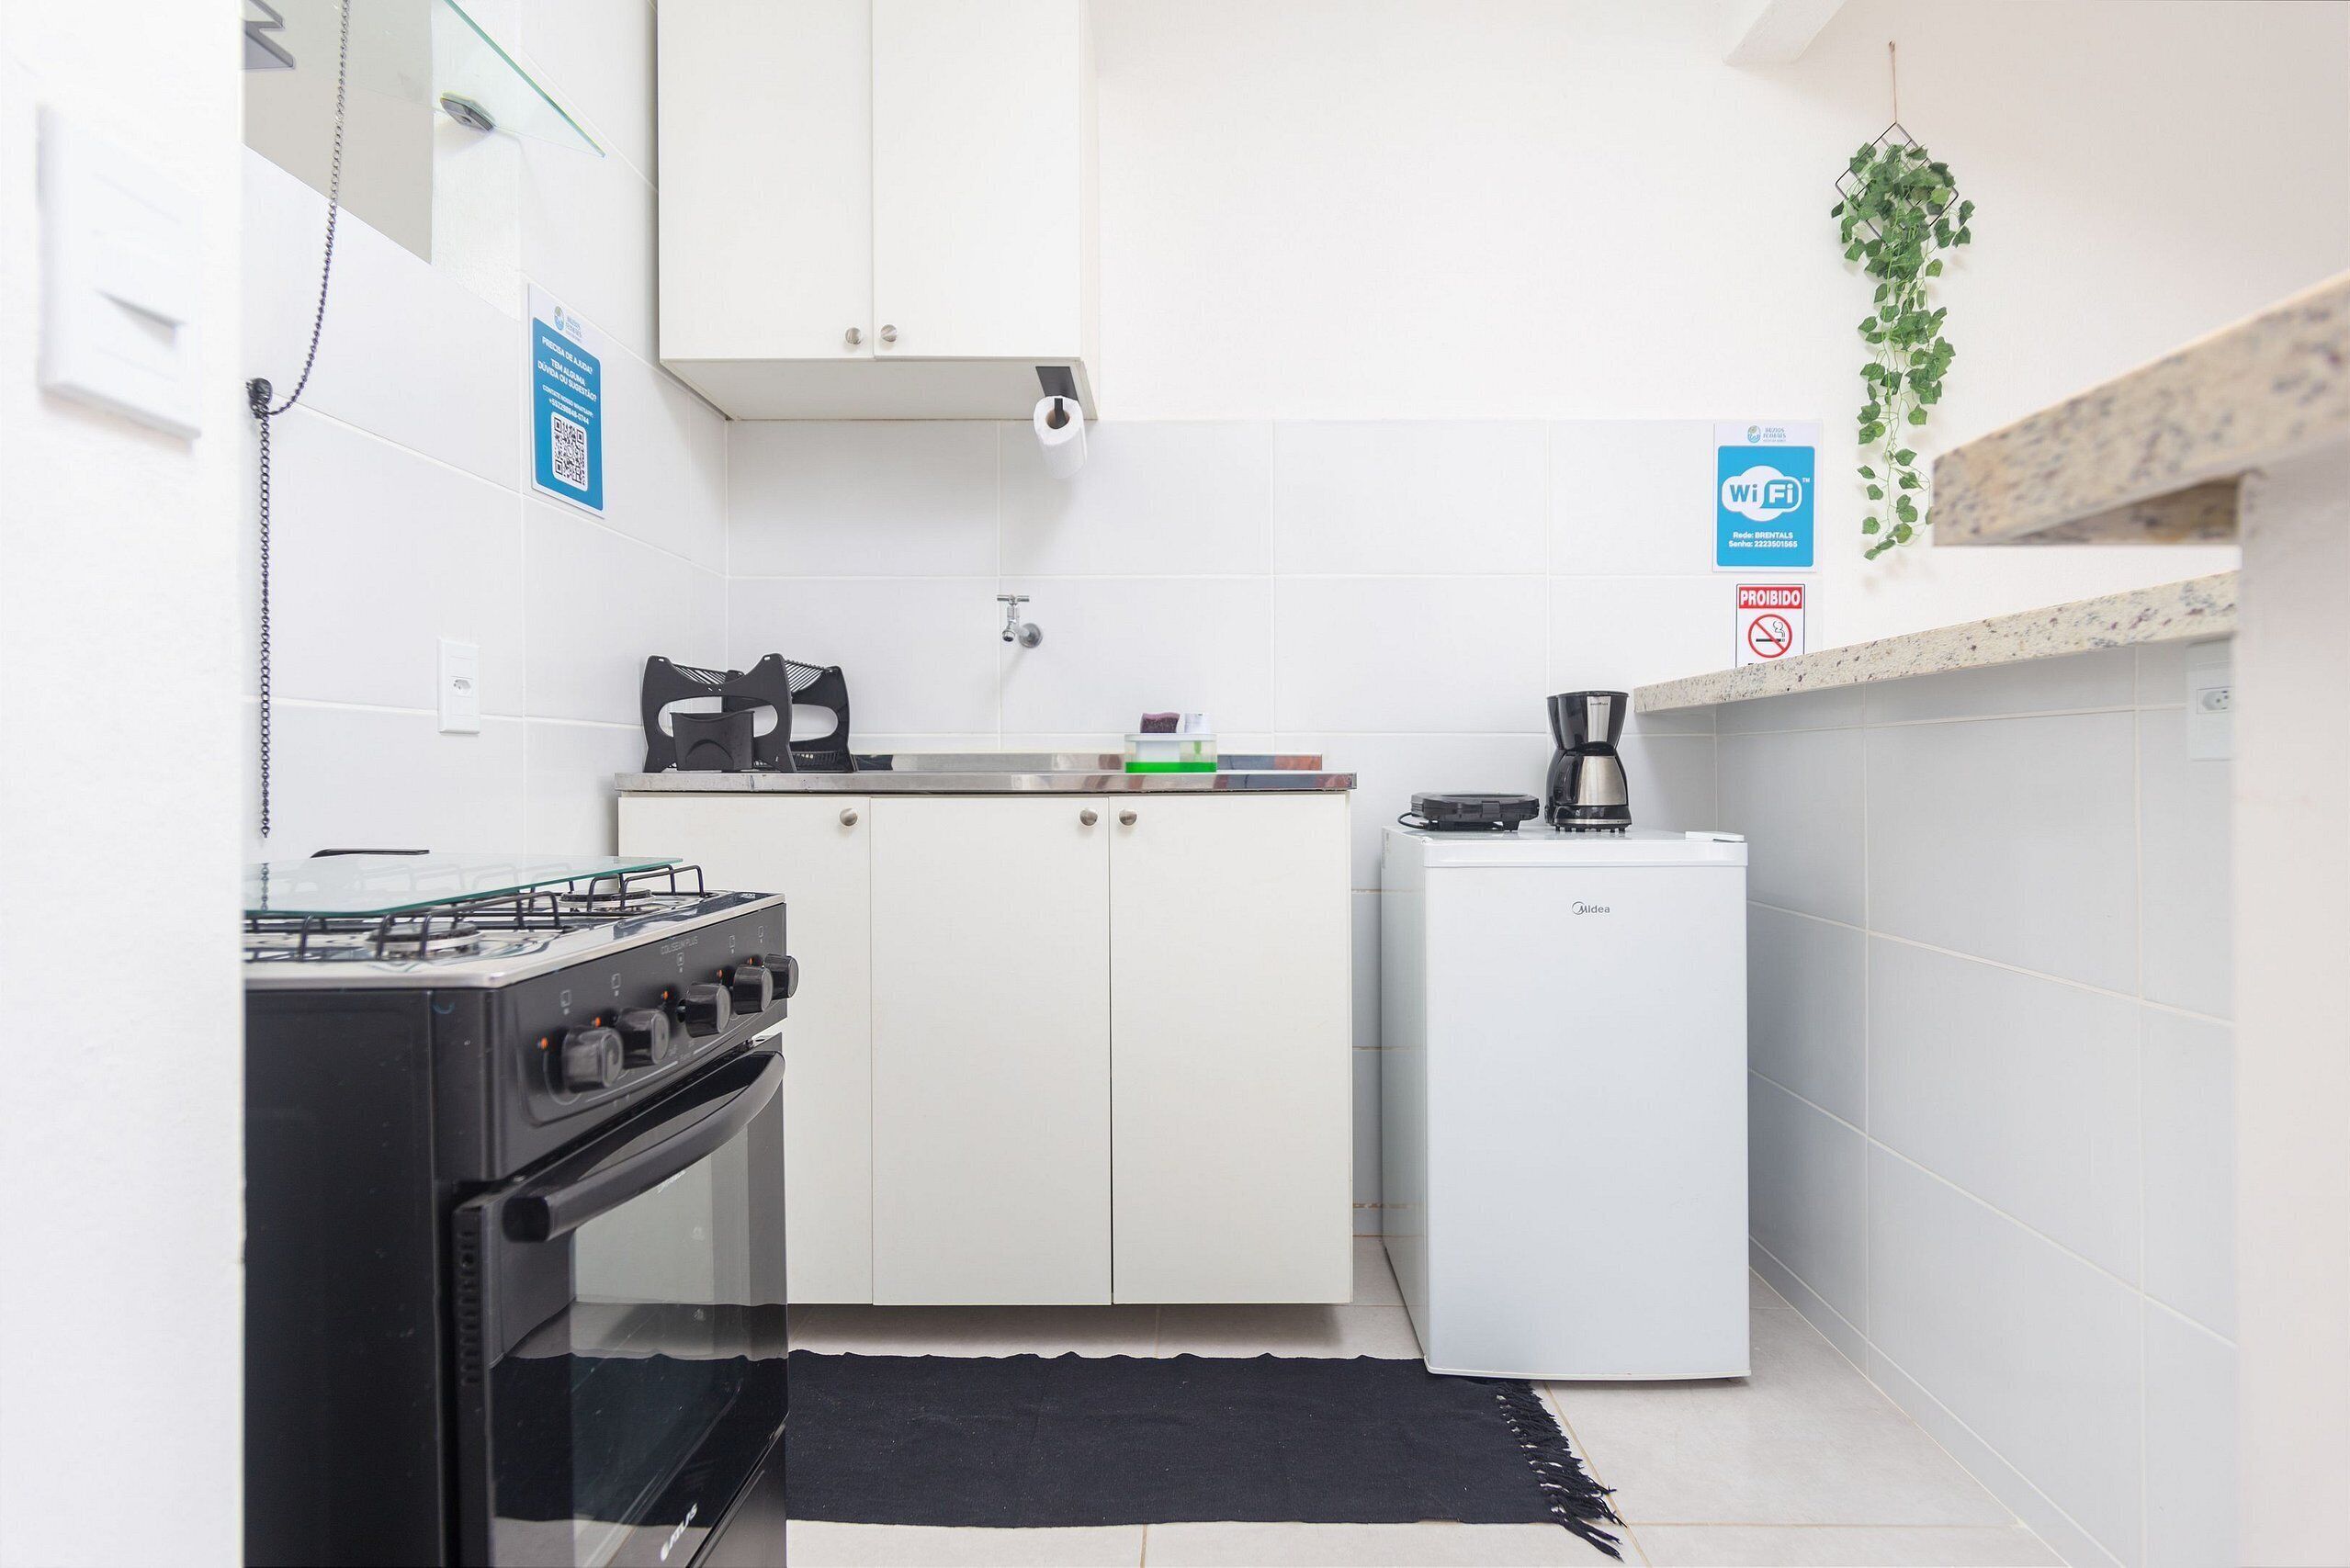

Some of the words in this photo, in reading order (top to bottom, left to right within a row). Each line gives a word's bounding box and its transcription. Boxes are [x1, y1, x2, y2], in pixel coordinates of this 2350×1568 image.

[542, 336, 565, 357] PRECISA
[551, 358, 563, 373] TEM
[1755, 531, 1794, 539] BRENTALS
[1740, 590, 1801, 606] PROIBIDO
[1572, 901, 1610, 916] Midea
